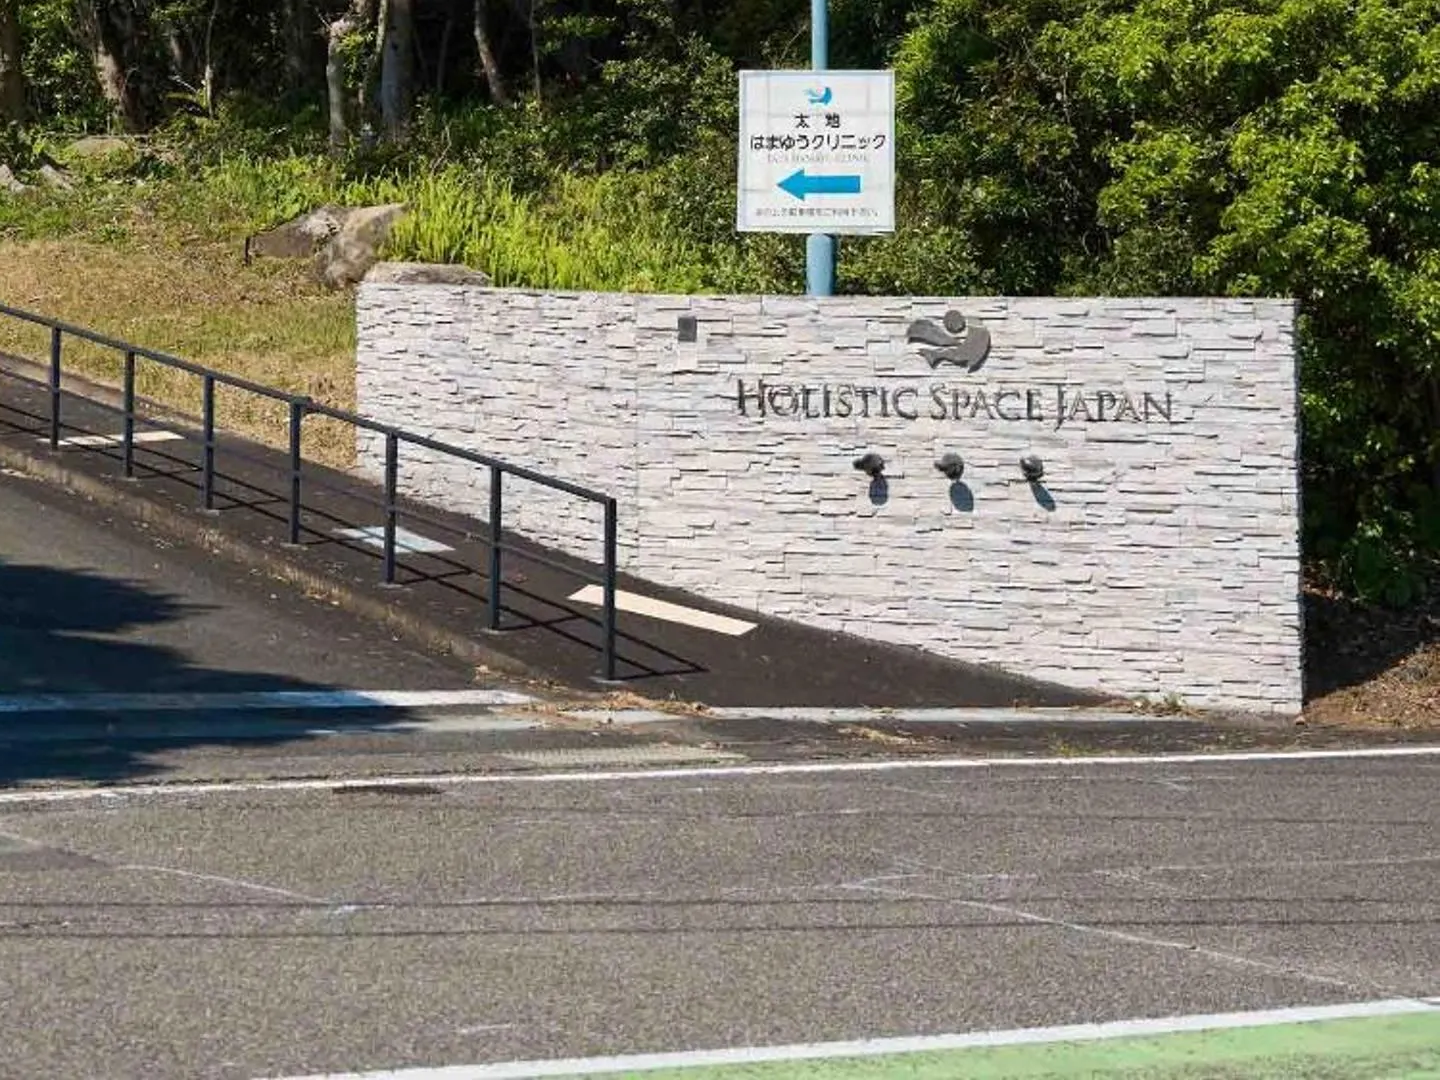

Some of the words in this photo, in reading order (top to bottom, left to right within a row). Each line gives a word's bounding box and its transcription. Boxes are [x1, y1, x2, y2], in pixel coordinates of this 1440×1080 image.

[750, 133, 886, 151] はまゆうクリニック
[737, 378, 919, 421] HOLISTIC
[928, 382, 1044, 422] SPACE
[1054, 383, 1173, 432] JAPAN
